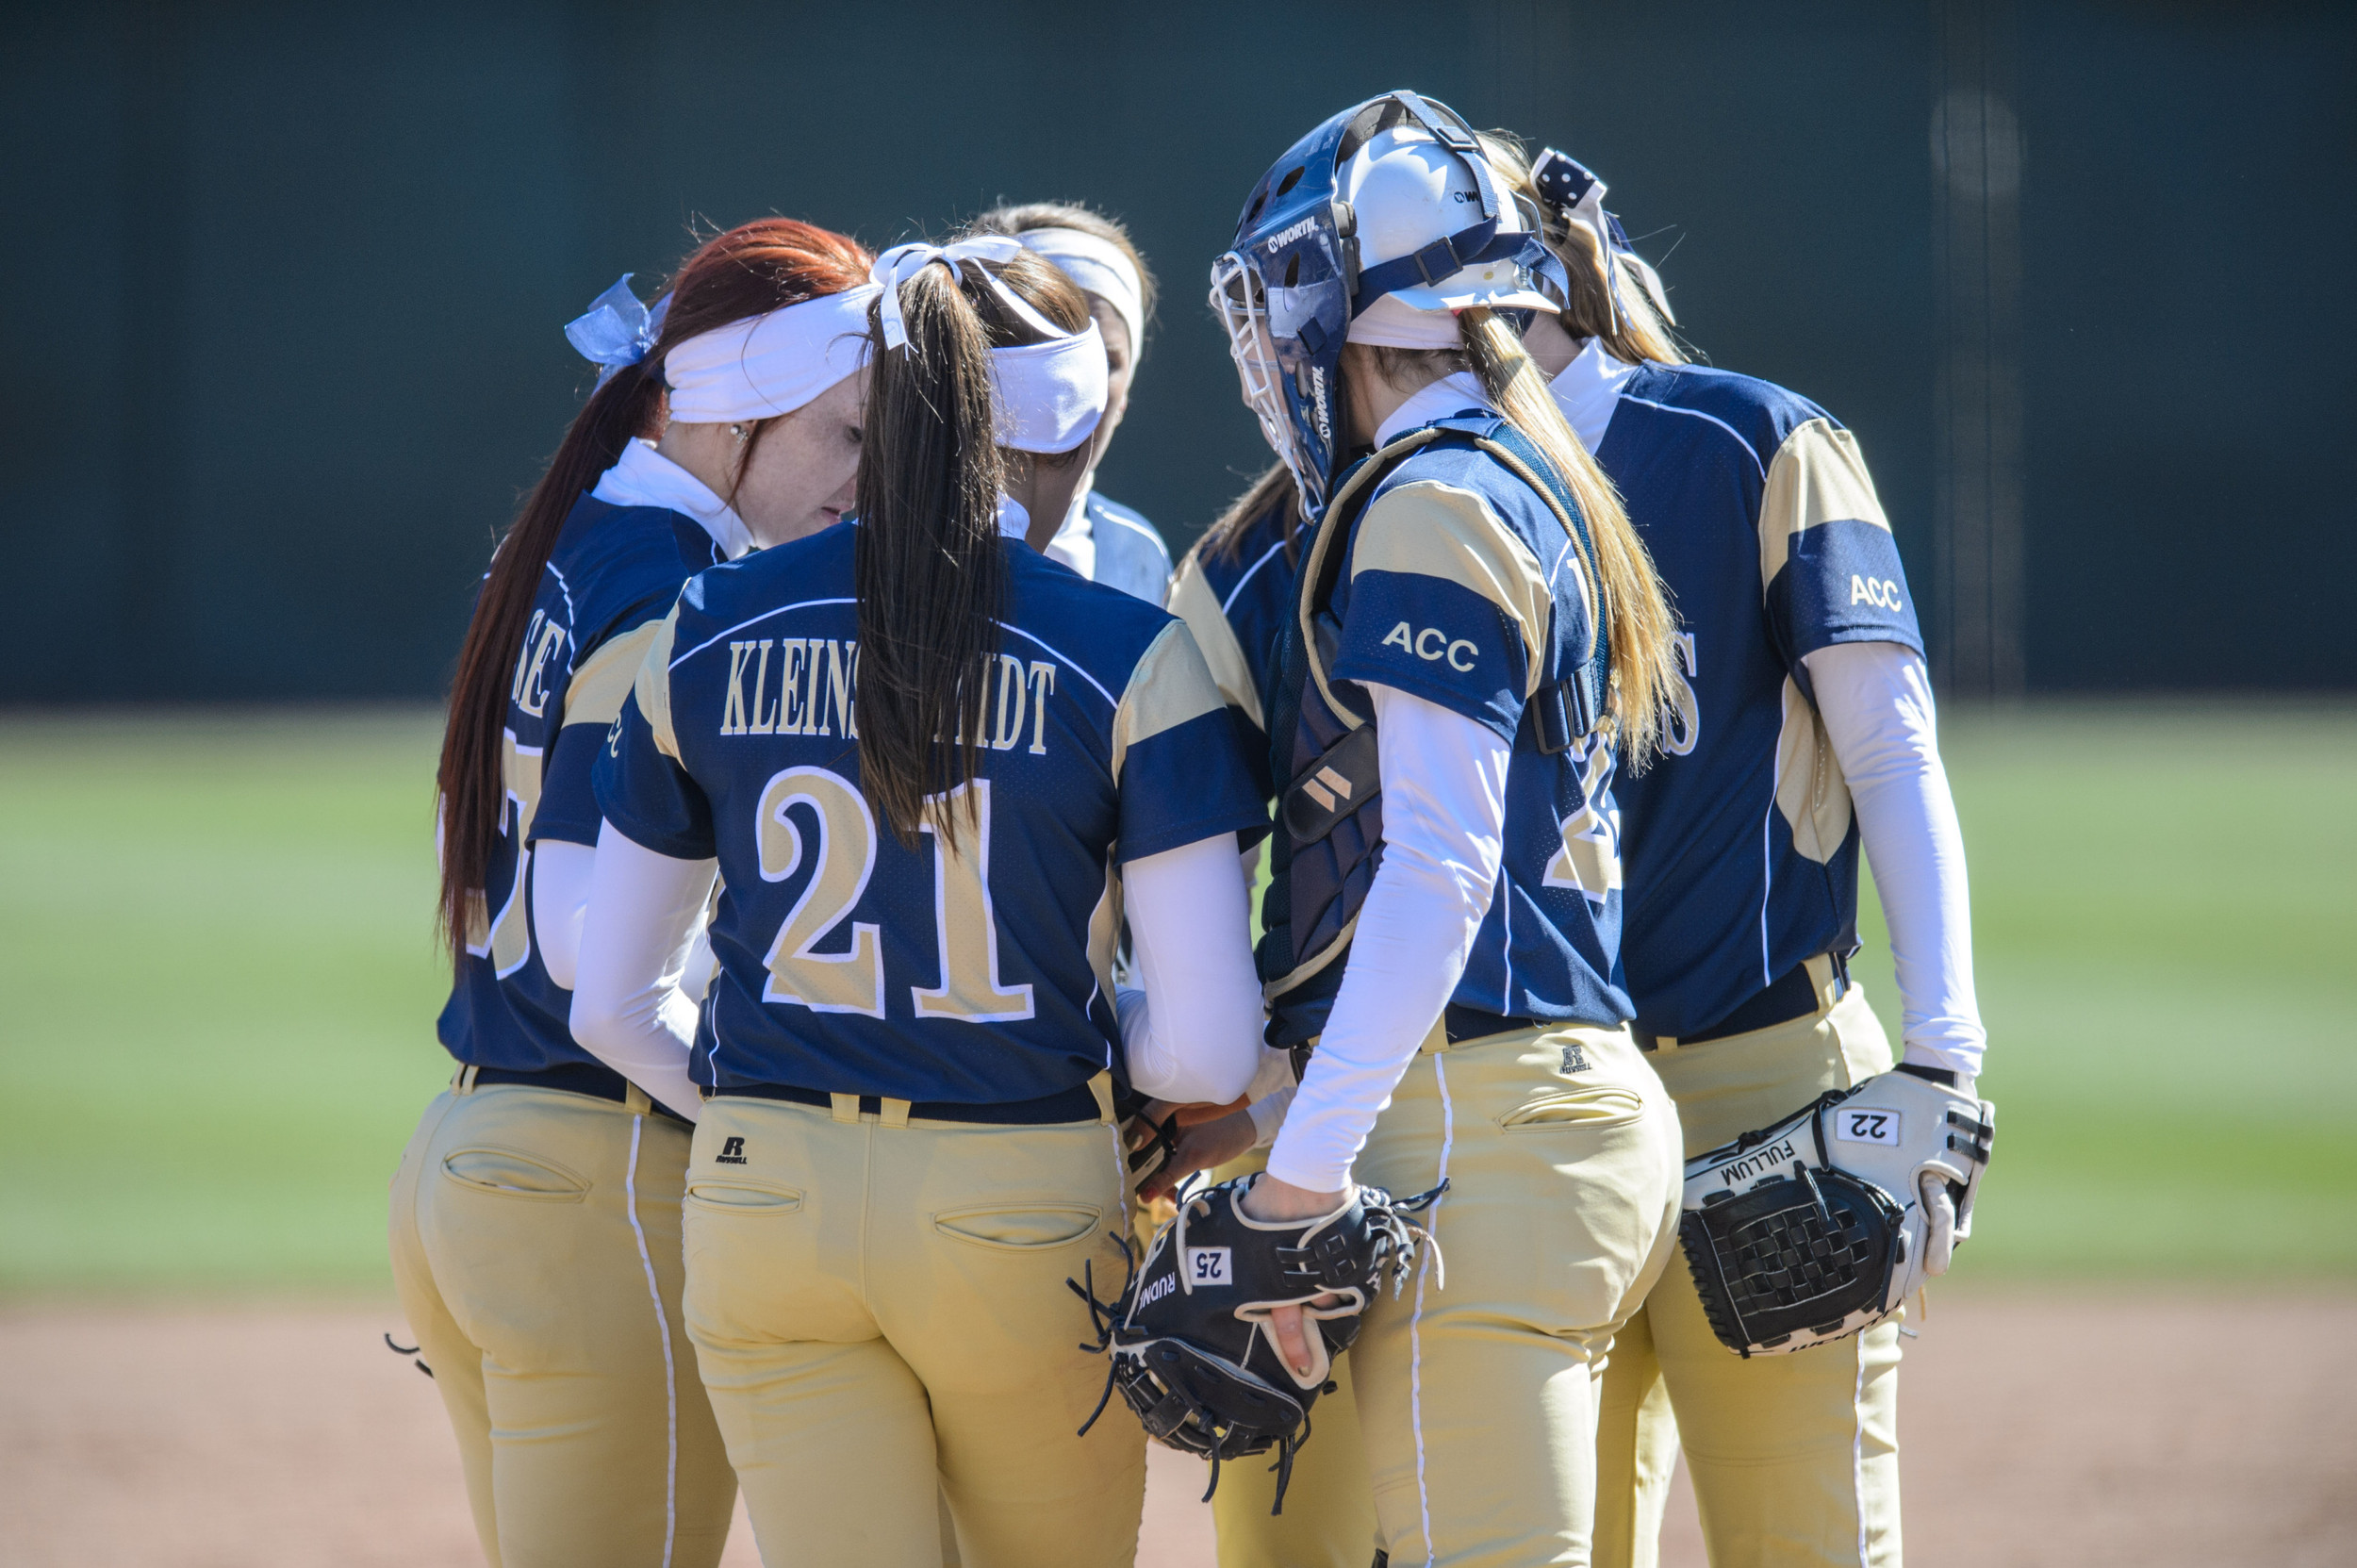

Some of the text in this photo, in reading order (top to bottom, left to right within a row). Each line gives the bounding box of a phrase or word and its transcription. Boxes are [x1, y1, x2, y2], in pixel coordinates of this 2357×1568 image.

[1277, 215, 1315, 248] WORTH
[1311, 366, 1329, 424] WORTH
[1851, 574, 1903, 613] ACC
[1381, 621, 1479, 672] ACC
[755, 765, 1035, 1024] 21
[1851, 1114, 1887, 1139] 22
[715, 1155, 748, 1164] RUSSELL
[722, 1136, 745, 1156] R
[1721, 1139, 1796, 1186] FULLUM
[1196, 1252, 1222, 1279] 25
